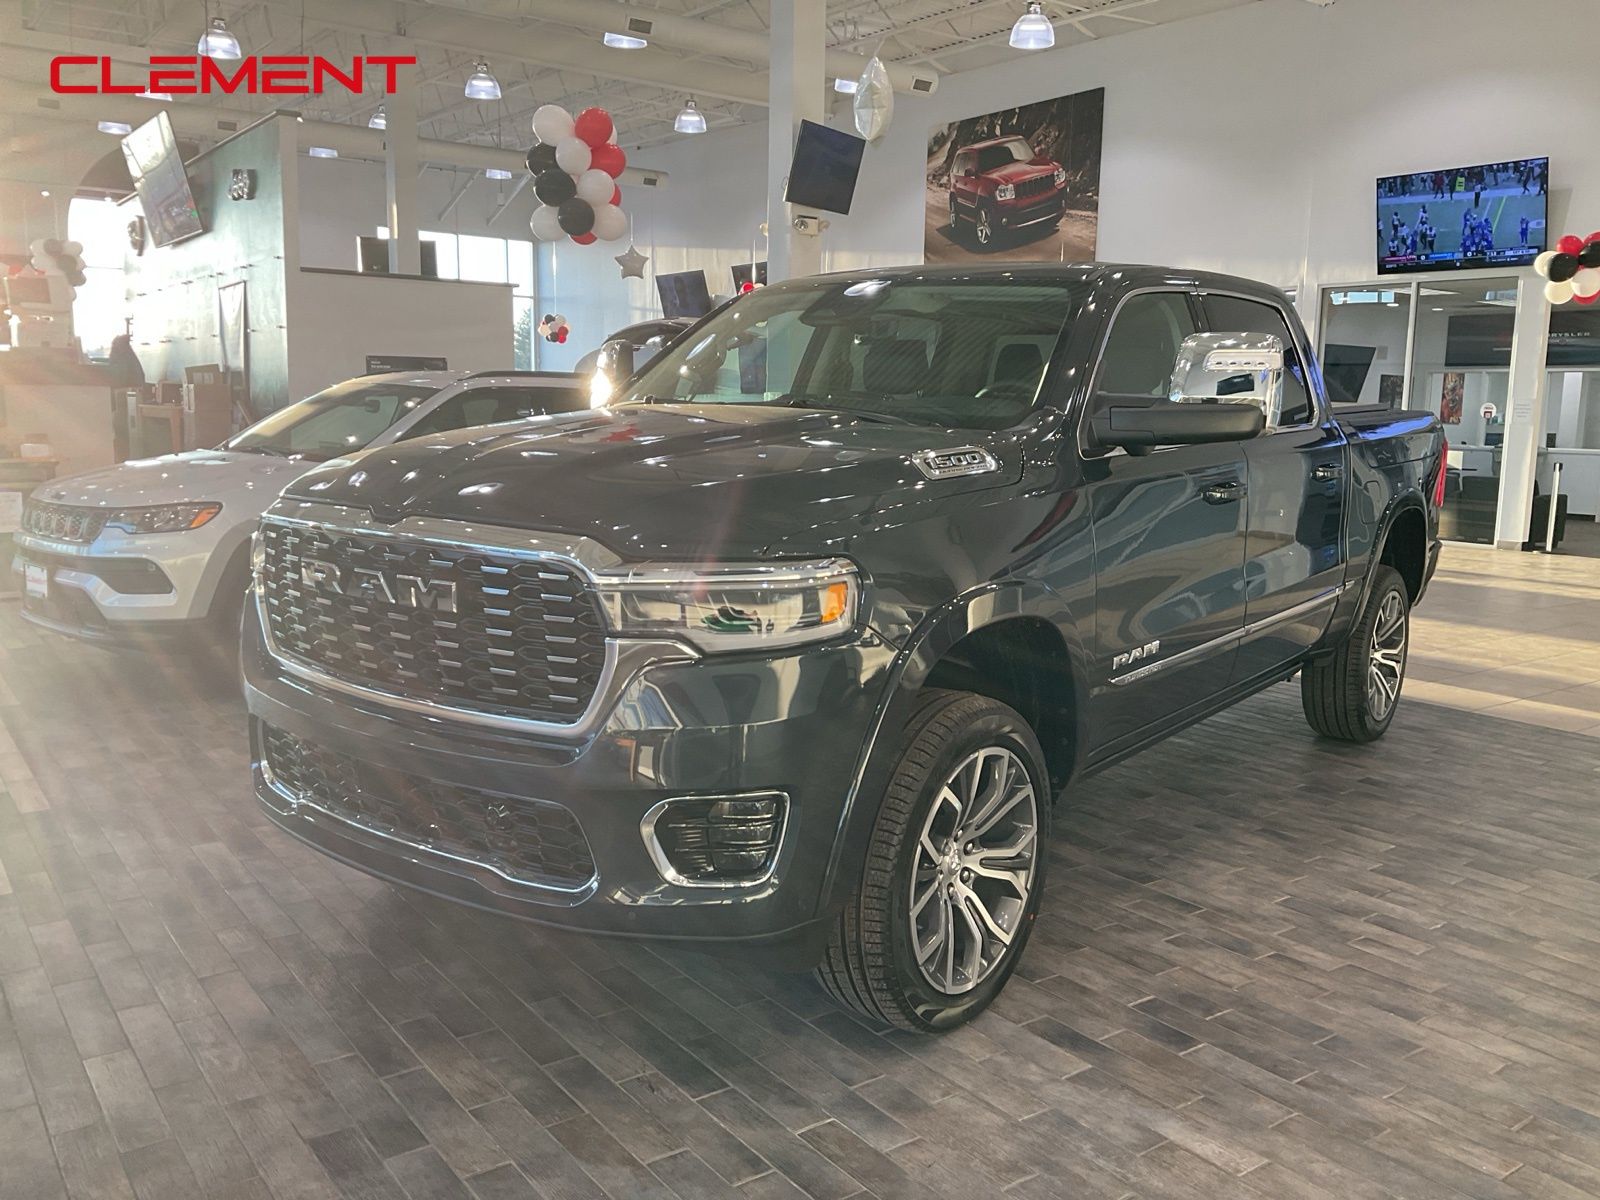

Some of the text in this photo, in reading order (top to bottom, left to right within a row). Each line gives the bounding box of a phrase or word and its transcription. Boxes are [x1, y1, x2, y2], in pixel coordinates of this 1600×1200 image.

[925, 452, 983, 470] 1500
[300, 557, 458, 614] RAM
[1112, 639, 1161, 671] RAM
